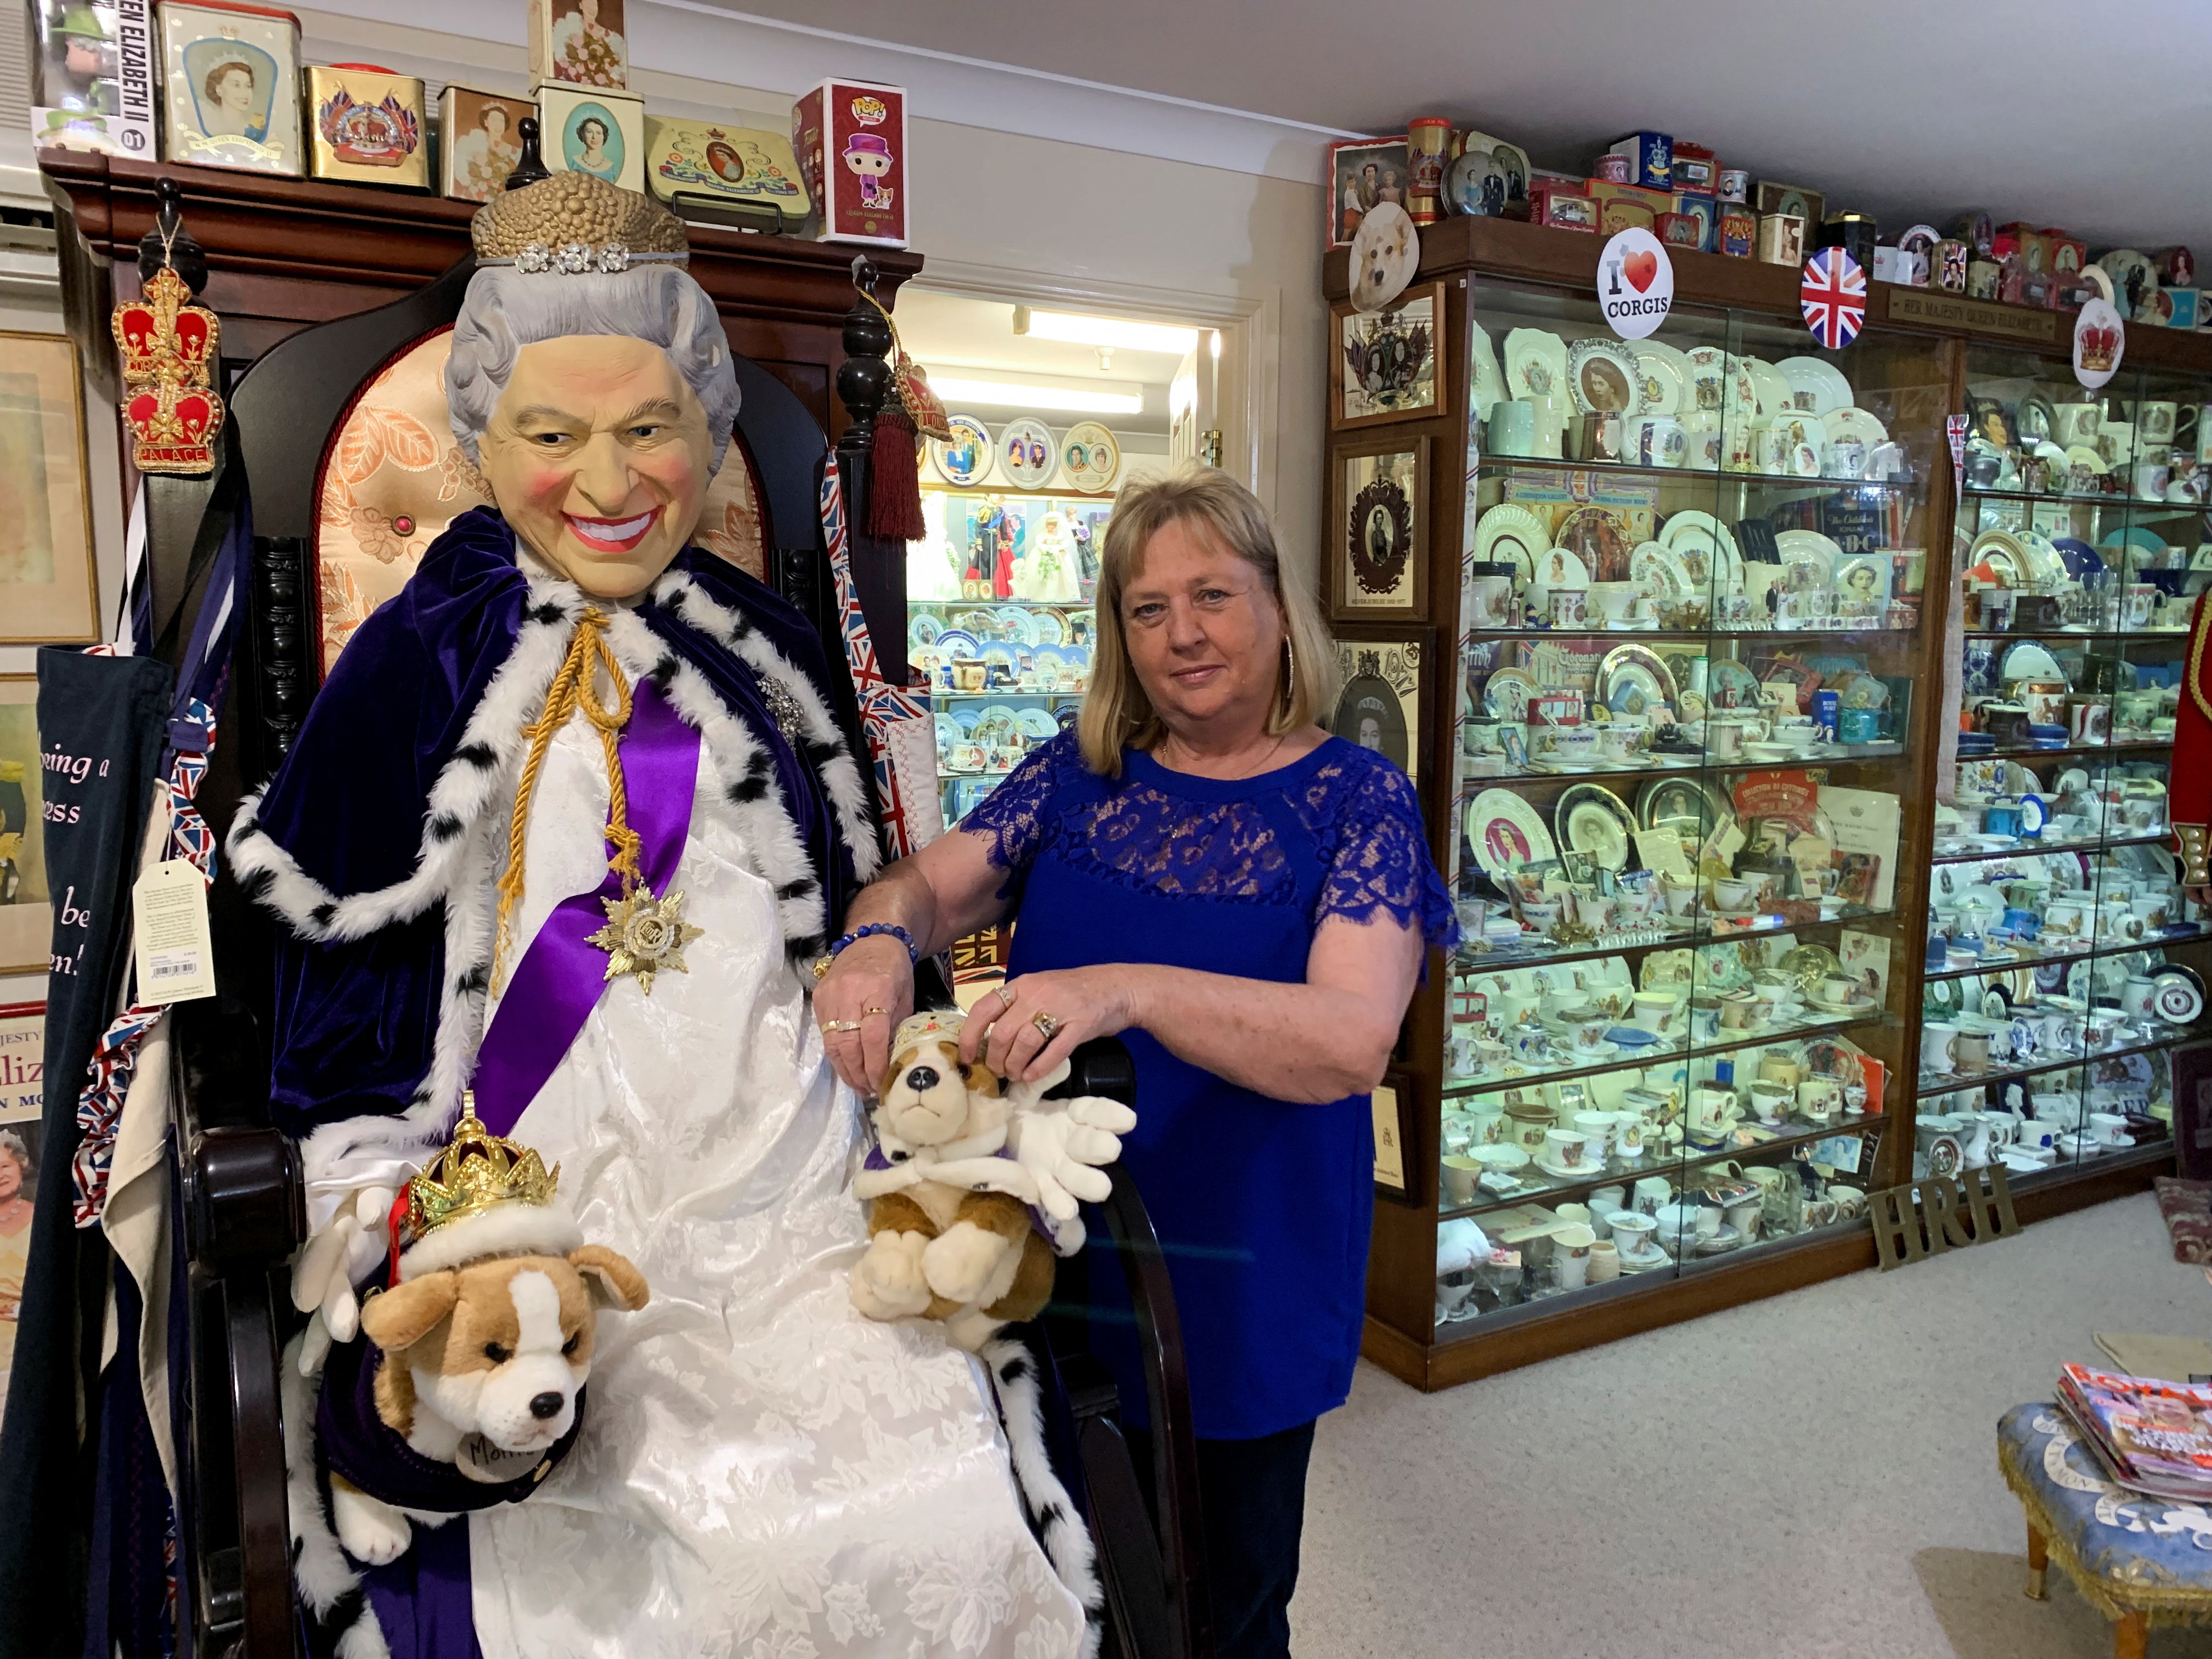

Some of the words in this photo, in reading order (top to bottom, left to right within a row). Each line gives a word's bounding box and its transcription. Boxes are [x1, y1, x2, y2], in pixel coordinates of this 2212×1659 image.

[119, 0, 144, 22] EN
[120, 25, 148, 108] ELIZABETH
[125, 110, 149, 122] II
[851, 98, 885, 117] POP!
[123, 132, 142, 148] 01
[1606, 260, 1622, 295] I
[1607, 297, 1667, 318] CORGIS
[99, 759, 110, 777] a
[61, 885, 91, 928] be
[0, 1054, 43, 1086] liz
[1867, 1162, 2024, 1273] HRH
